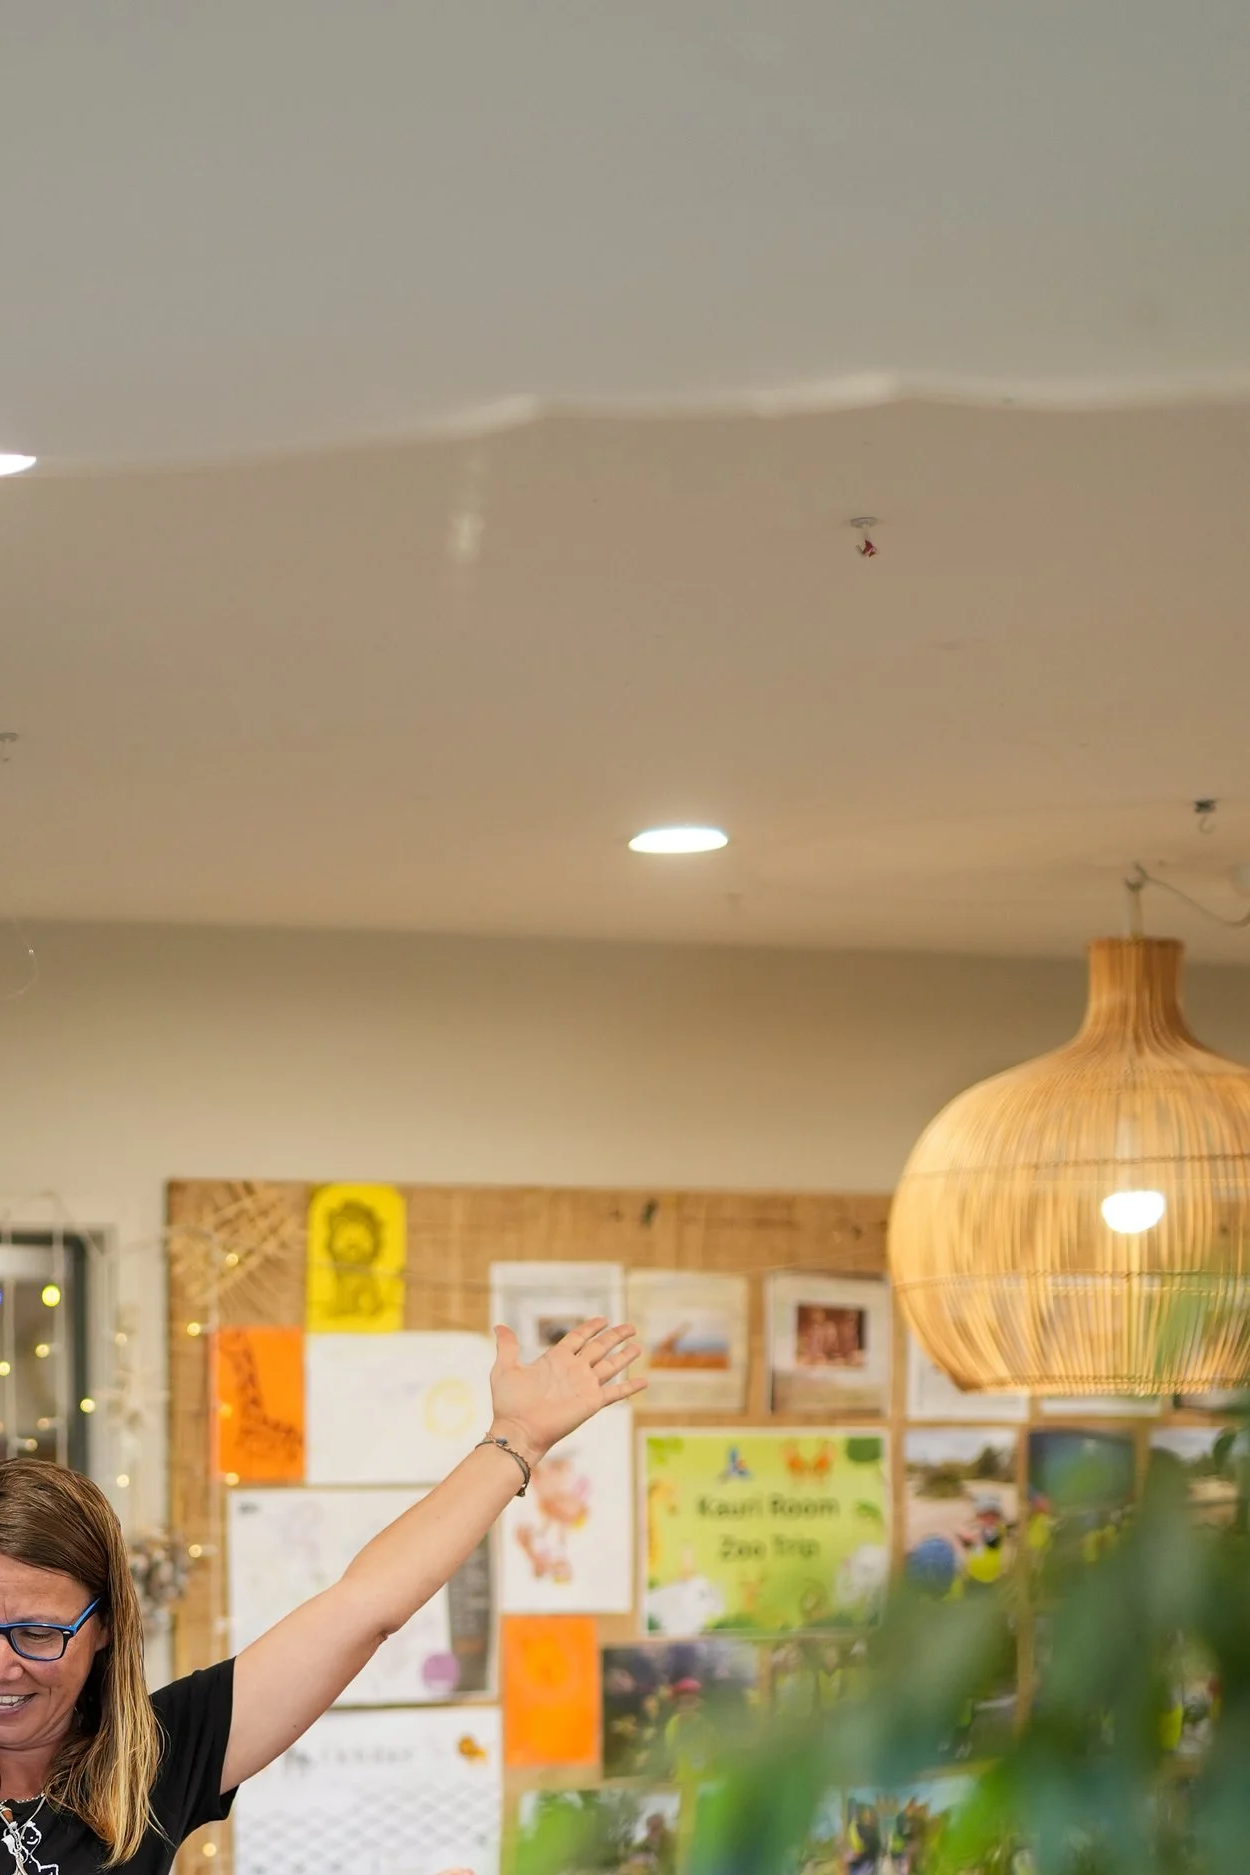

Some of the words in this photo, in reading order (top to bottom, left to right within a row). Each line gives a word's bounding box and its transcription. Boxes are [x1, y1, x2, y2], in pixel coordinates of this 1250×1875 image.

[770, 1493, 839, 1518] Room
[721, 1536, 765, 1561] Zoo
[772, 1534, 819, 1563] Trip
